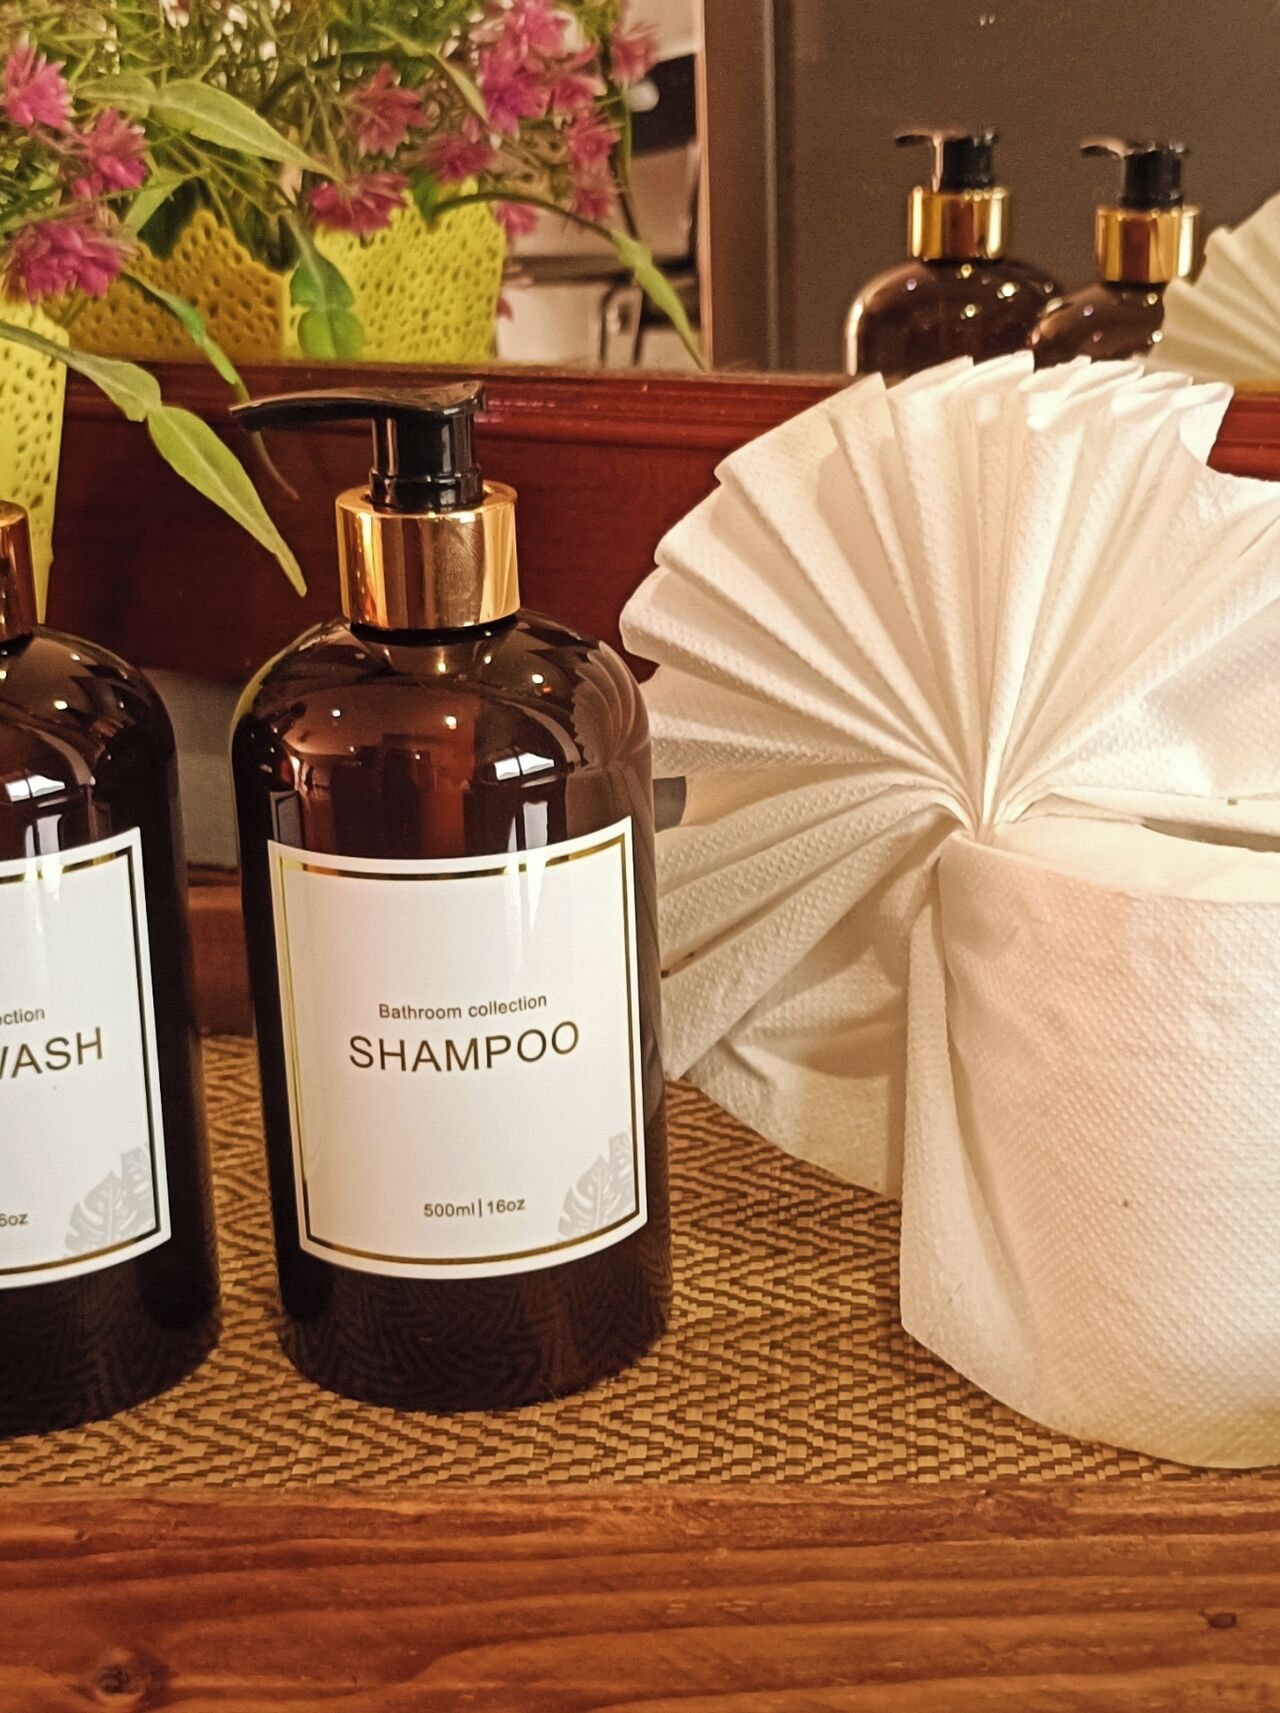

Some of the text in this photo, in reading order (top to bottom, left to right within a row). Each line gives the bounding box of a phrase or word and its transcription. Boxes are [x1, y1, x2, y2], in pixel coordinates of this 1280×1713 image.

[379, 996, 547, 1020] Bathroom collection
[349, 1021, 578, 1072] SHAMPOO
